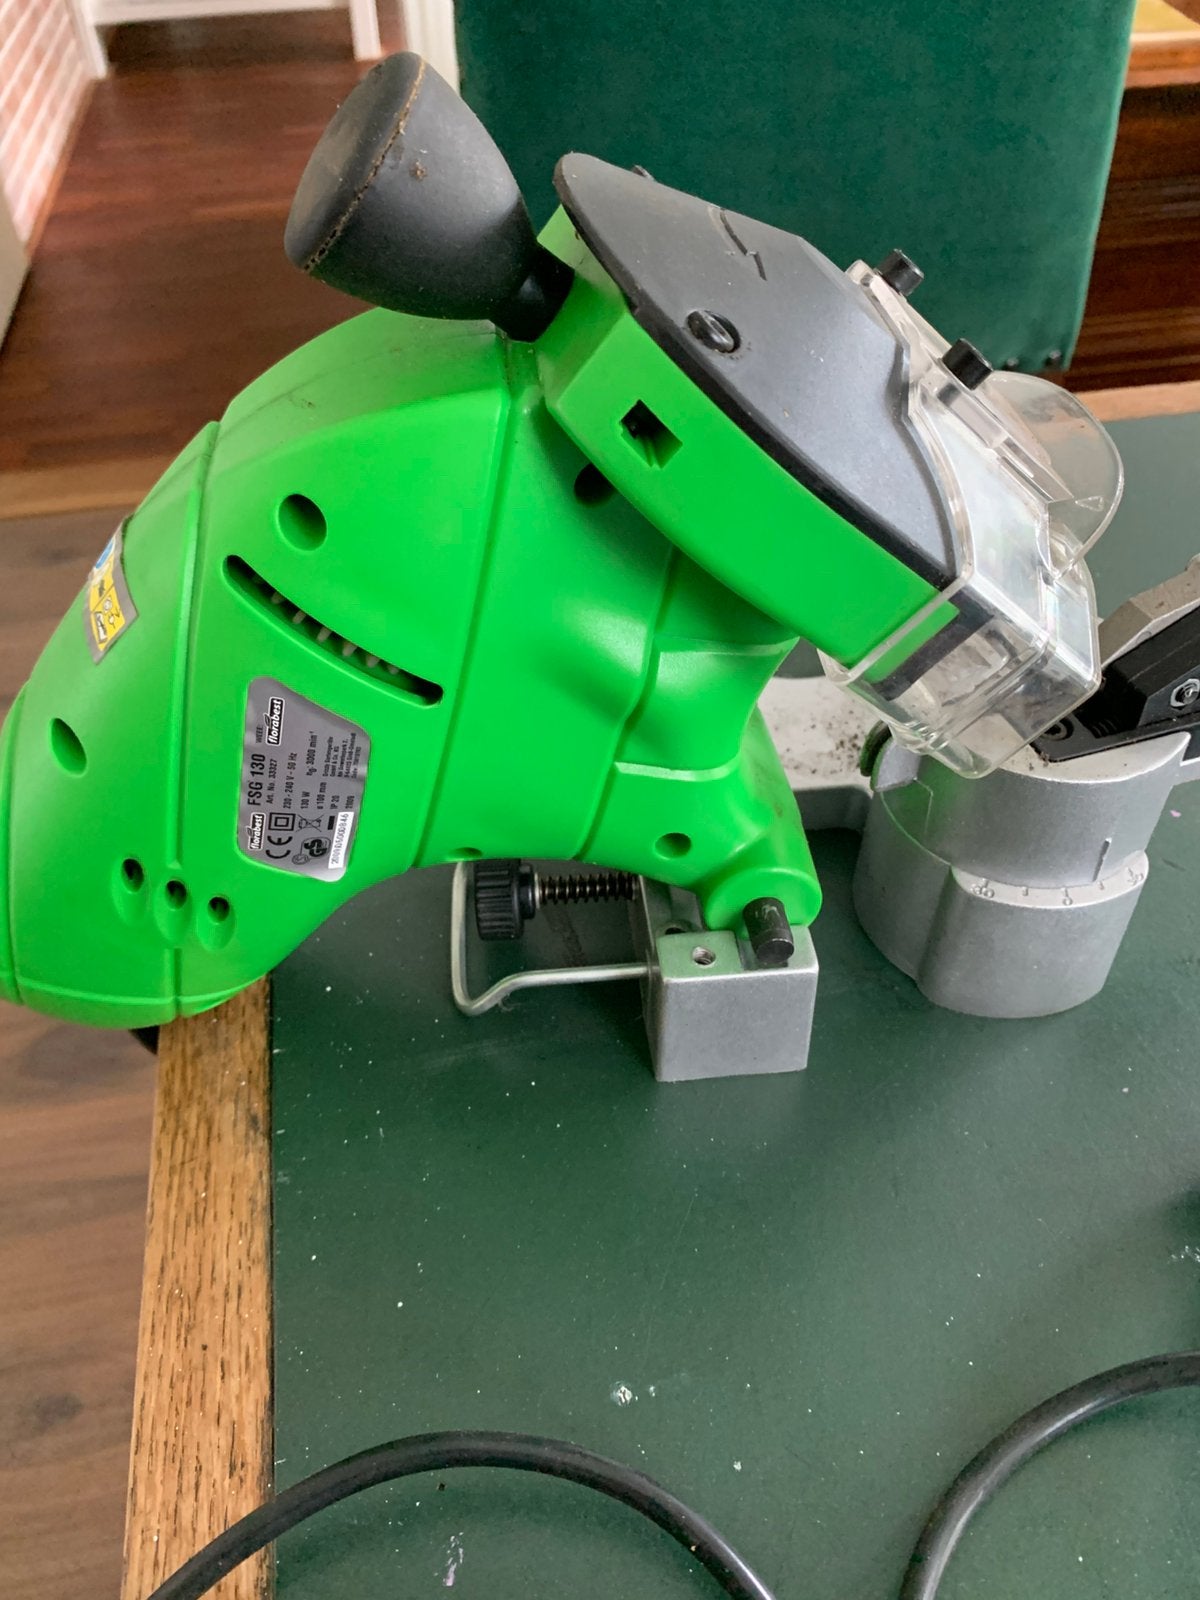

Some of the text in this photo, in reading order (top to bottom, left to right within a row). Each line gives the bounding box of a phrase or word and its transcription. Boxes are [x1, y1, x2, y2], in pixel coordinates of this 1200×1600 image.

[268, 700, 282, 744] florabest
[288, 752, 297, 761] Hz
[306, 749, 316, 765] 3000
[268, 759, 277, 778] 33327
[287, 762, 296, 770] 50
[248, 754, 265, 806] FSG 130
[284, 782, 294, 792] 240
[319, 782, 327, 793] mm
[266, 793, 274, 804] Art.
[282, 798, 292, 809] 230
[300, 799, 309, 809] 130
[316, 794, 325, 804] 100
[251, 814, 262, 849] florabest
